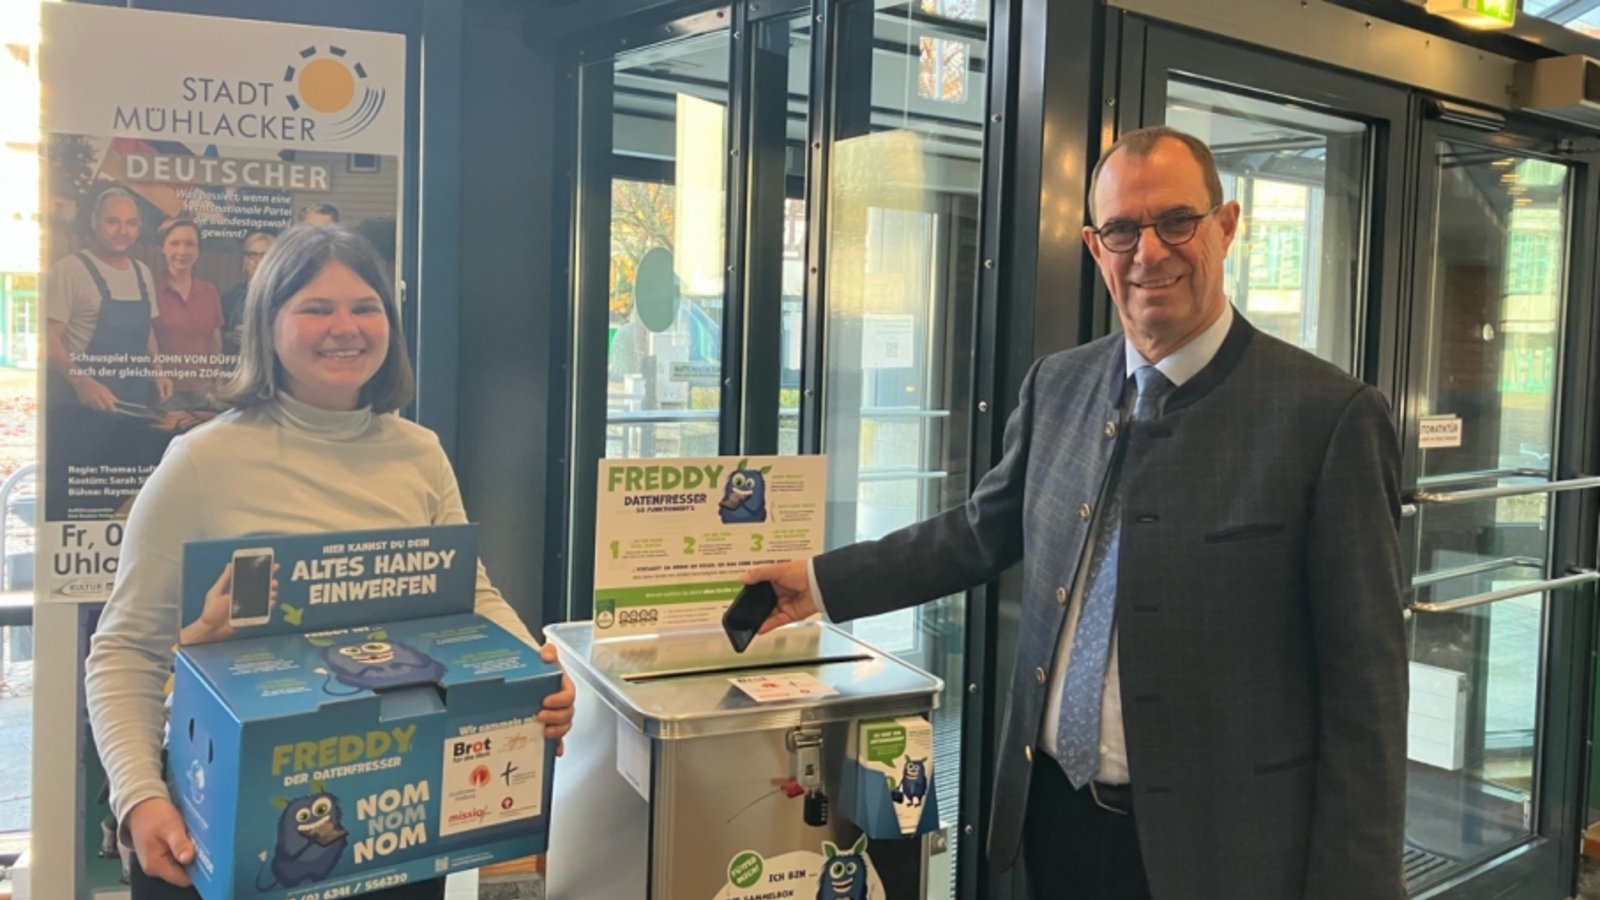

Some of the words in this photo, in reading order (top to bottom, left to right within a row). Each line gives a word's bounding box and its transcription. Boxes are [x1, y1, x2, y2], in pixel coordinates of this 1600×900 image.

[182, 76, 274, 107] STADT
[113, 105, 316, 142] MÜHLACKER
[126, 154, 328, 189] DEUTSCHER
[242, 194, 269, 203] wenn
[271, 194, 292, 204] eine
[263, 206, 292, 217] Partei
[201, 228, 248, 240] gewinnt?
[69, 352, 128, 366] Schauspiel
[130, 355, 150, 364] von
[152, 354, 182, 365] JOHN
[183, 354, 208, 365] VON
[69, 366, 96, 377] nach
[98, 367, 117, 378] der
[119, 367, 197, 379] gleichnamigen
[68, 465, 98, 476] Regie:
[100, 466, 136, 474] Thomas
[607, 464, 724, 492] FREDDY
[68, 476, 108, 486] Kostüm:
[109, 476, 137, 485] Sarah
[68, 487, 101, 497] Bühne:
[624, 493, 707, 507] DATENFRESSER
[62, 523, 94, 550] Fr,
[683, 536, 696, 554] 2
[750, 533, 764, 552] 3
[322, 544, 345, 555] HIER
[348, 541, 387, 553] KANNST
[390, 540, 405, 549] DU
[407, 538, 430, 548] DEIN
[609, 540, 619, 560] 1
[291, 556, 365, 581] ALTES
[374, 549, 456, 575] HANDY
[309, 574, 437, 605] EINWERFEN
[458, 724, 478, 736] Wir
[271, 724, 416, 776] FREDDY
[453, 738, 491, 757] Brot
[284, 772, 308, 787] DER
[313, 756, 402, 781] DATENFRESSER
[356, 779, 430, 821] NOM
[368, 803, 427, 836] NOM
[353, 822, 427, 864] NOM
[768, 872, 785, 883] ICH
[788, 870, 806, 880] BIN
